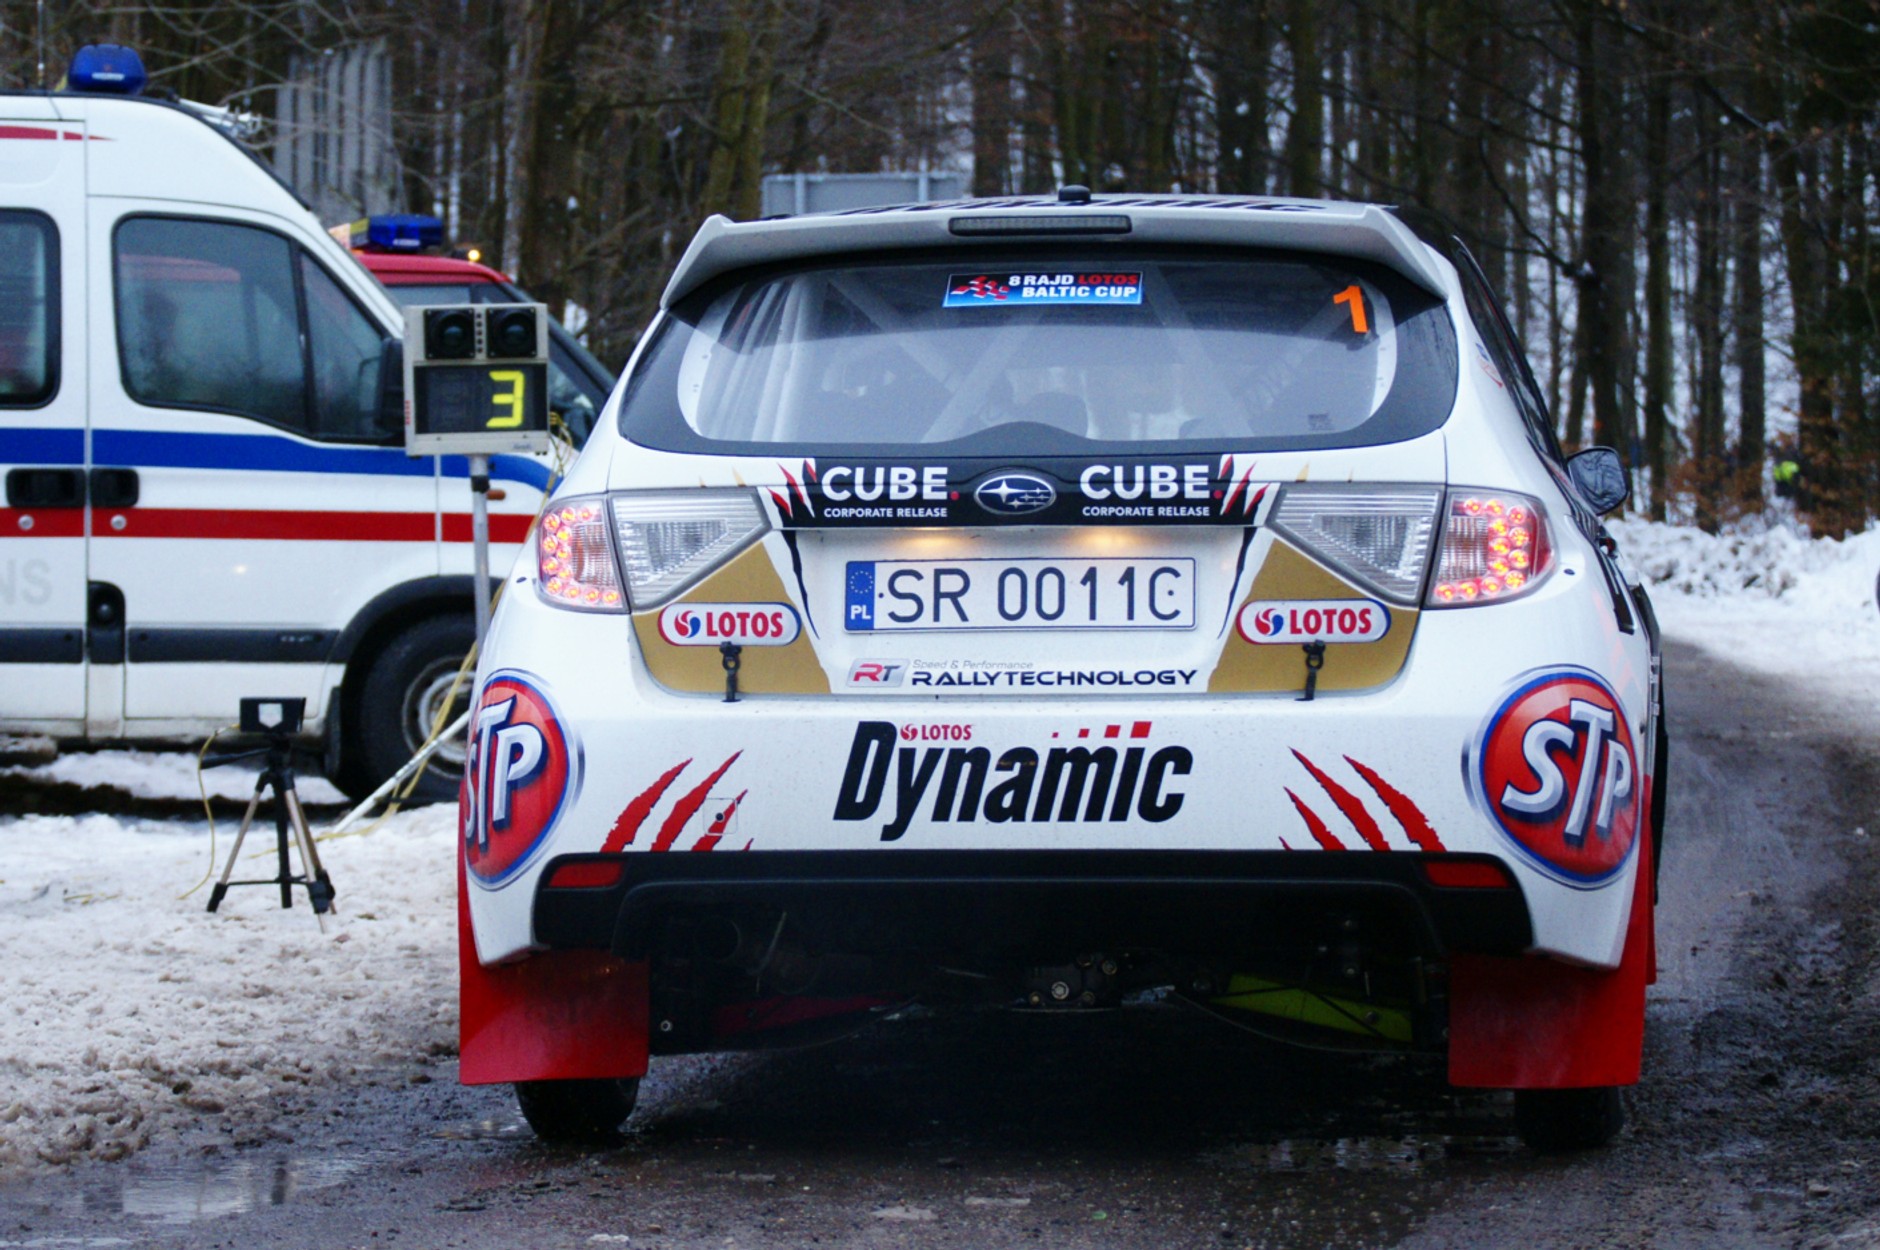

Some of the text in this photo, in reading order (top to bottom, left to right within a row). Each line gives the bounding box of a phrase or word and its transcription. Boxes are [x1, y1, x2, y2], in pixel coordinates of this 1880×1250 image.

[1008, 274, 1138, 286] 8 RAJD LOTOS
[1022, 286, 1137, 298] BALTIC CUP
[1333, 285, 1370, 334] 1
[486, 370, 525, 429] 3
[823, 507, 948, 518] CORPORATE RELEASE
[1082, 506, 1211, 517] CORPORATE RELEASE
[887, 566, 1182, 623] SR 0011C
[850, 605, 872, 620] PL
[1289, 608, 1372, 635] LOTOS
[706, 611, 784, 638] LOTOS
[852, 663, 902, 682] RT
[912, 659, 1034, 671] Speed & Performance
[911, 670, 1198, 686] RALLYTECHNOLOGY
[921, 724, 972, 741] LOTOS
[1500, 697, 1632, 837] STP
[832, 720, 1194, 842] Dynamic
